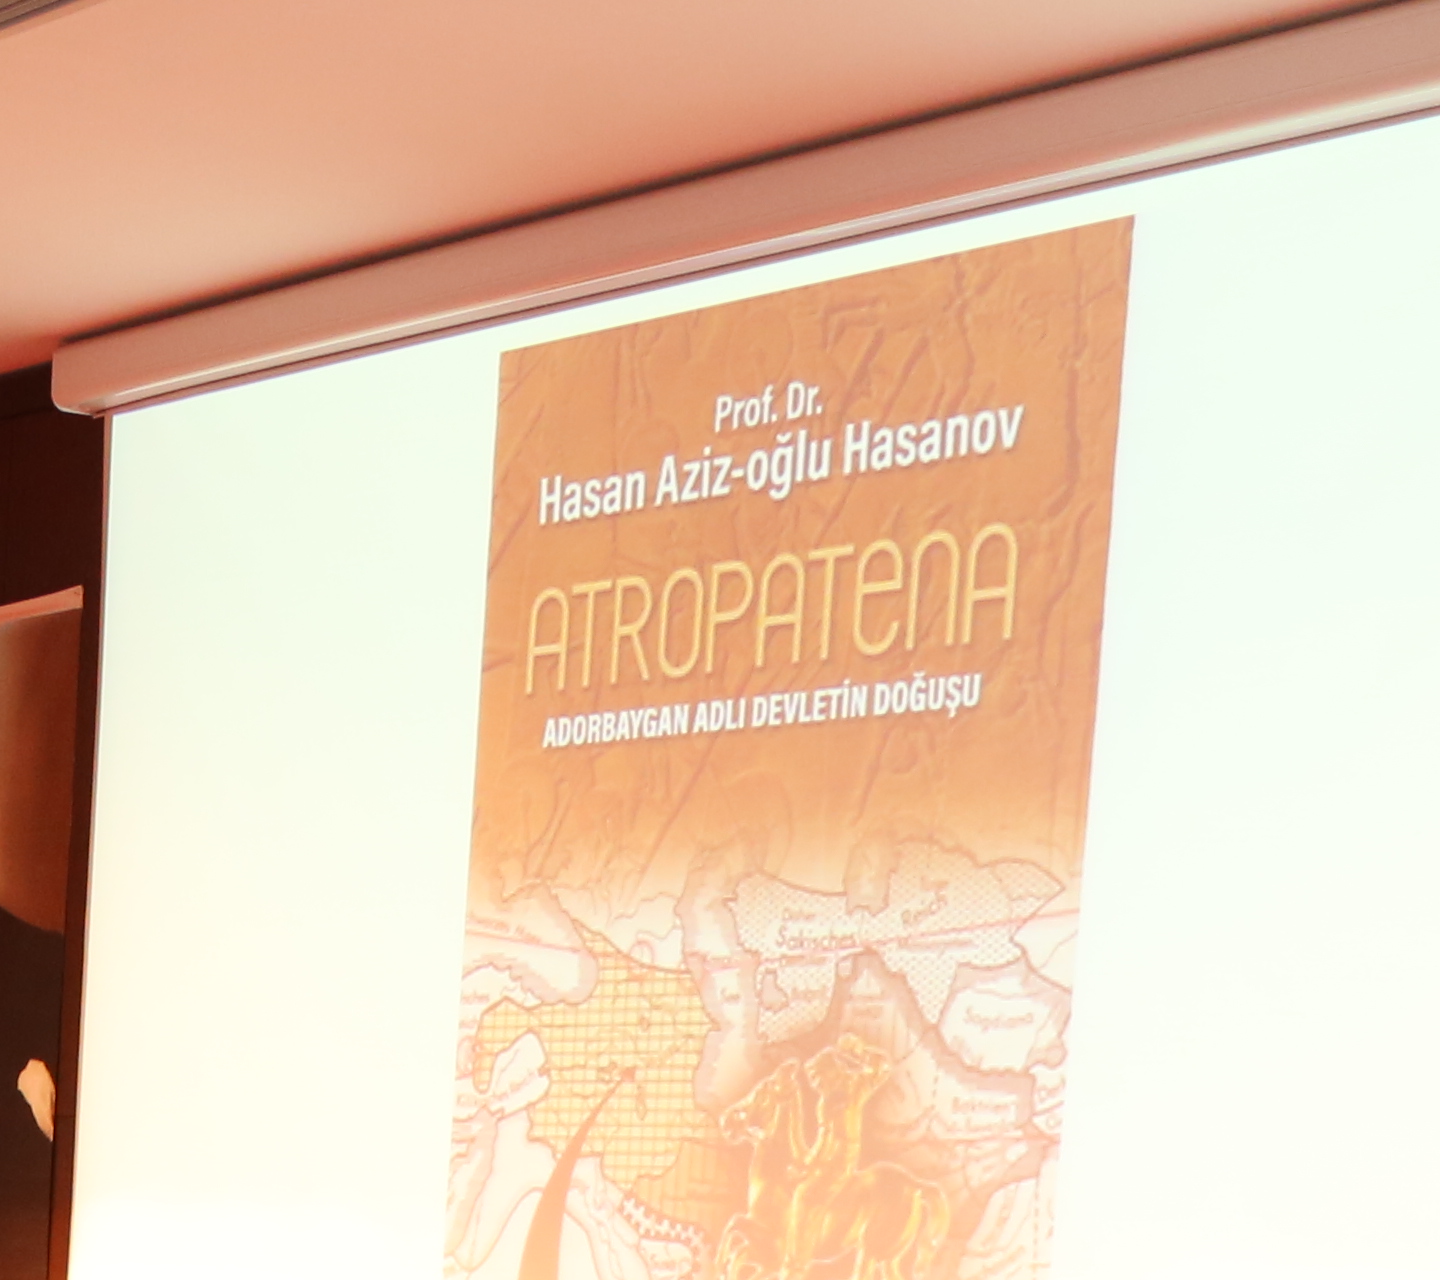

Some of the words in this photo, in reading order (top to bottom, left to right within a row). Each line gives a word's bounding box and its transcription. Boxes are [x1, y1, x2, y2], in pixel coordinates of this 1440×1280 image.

[714, 385, 778, 432] Prof.
[787, 381, 823, 421] Dr.
[539, 469, 645, 525] Hasan
[655, 429, 831, 506] Aziz-oğlu
[843, 404, 1024, 474] Hasanov
[525, 522, 1019, 695] ATROPATENA
[542, 704, 690, 749] ADORBAYGAN
[693, 698, 747, 734] ADLI
[752, 679, 868, 729] DEVLETİN
[873, 671, 982, 717] DOĞUŞU
